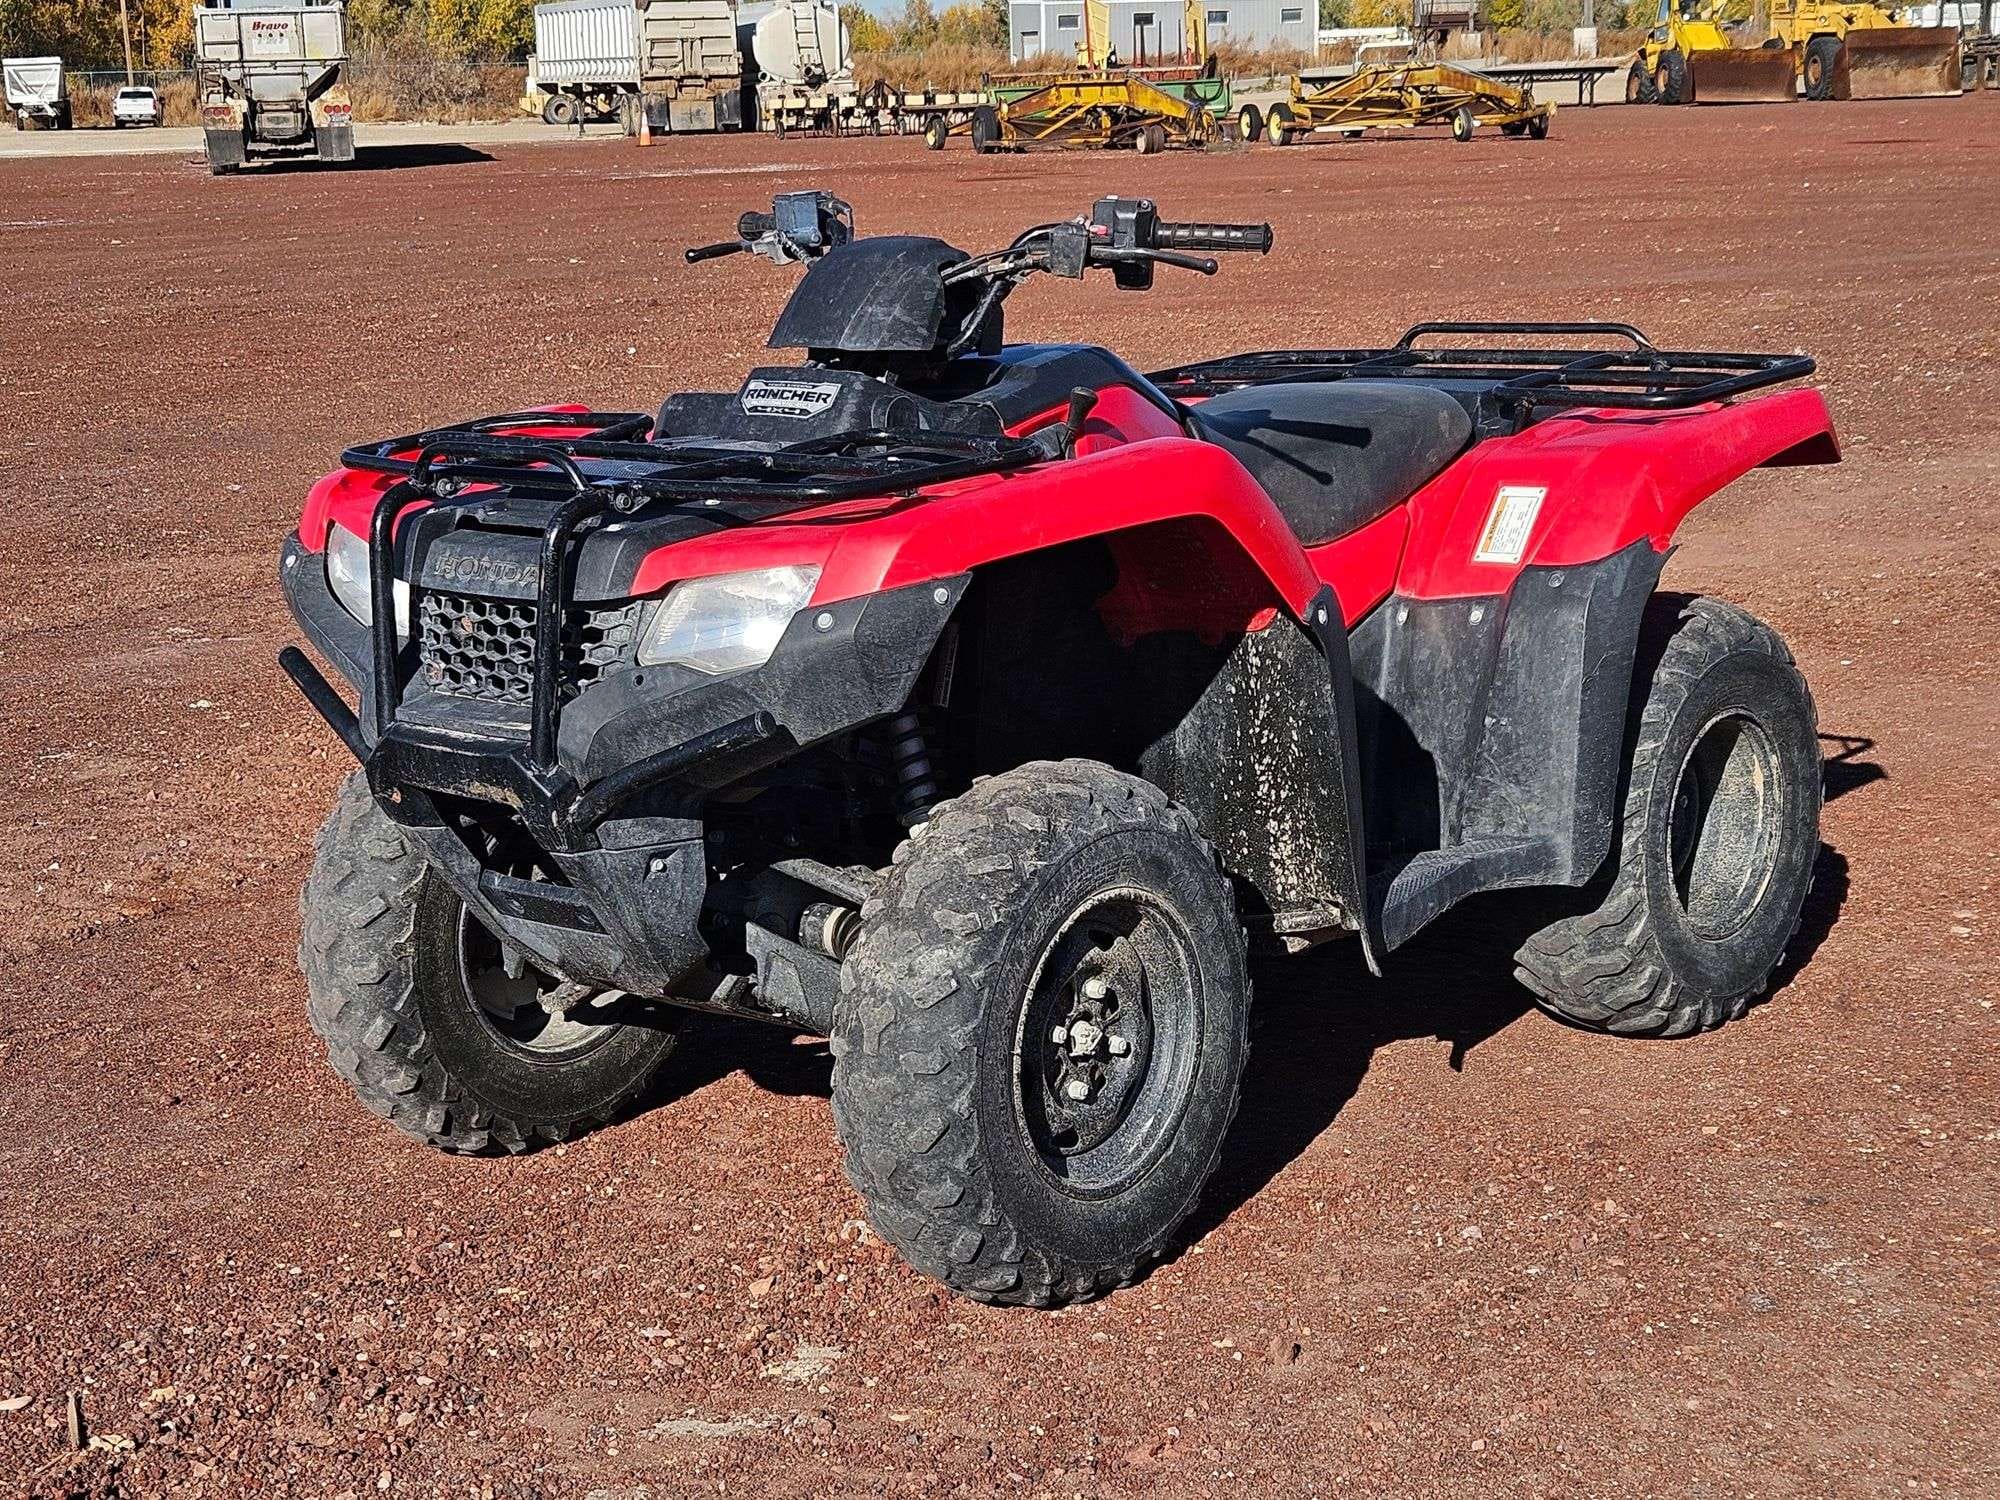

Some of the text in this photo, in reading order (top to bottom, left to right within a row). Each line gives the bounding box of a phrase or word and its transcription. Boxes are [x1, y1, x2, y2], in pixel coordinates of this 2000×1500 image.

[252, 21, 289, 31] Bravo
[745, 388, 832, 404] RANCHER
[434, 556, 540, 588] HONDA
